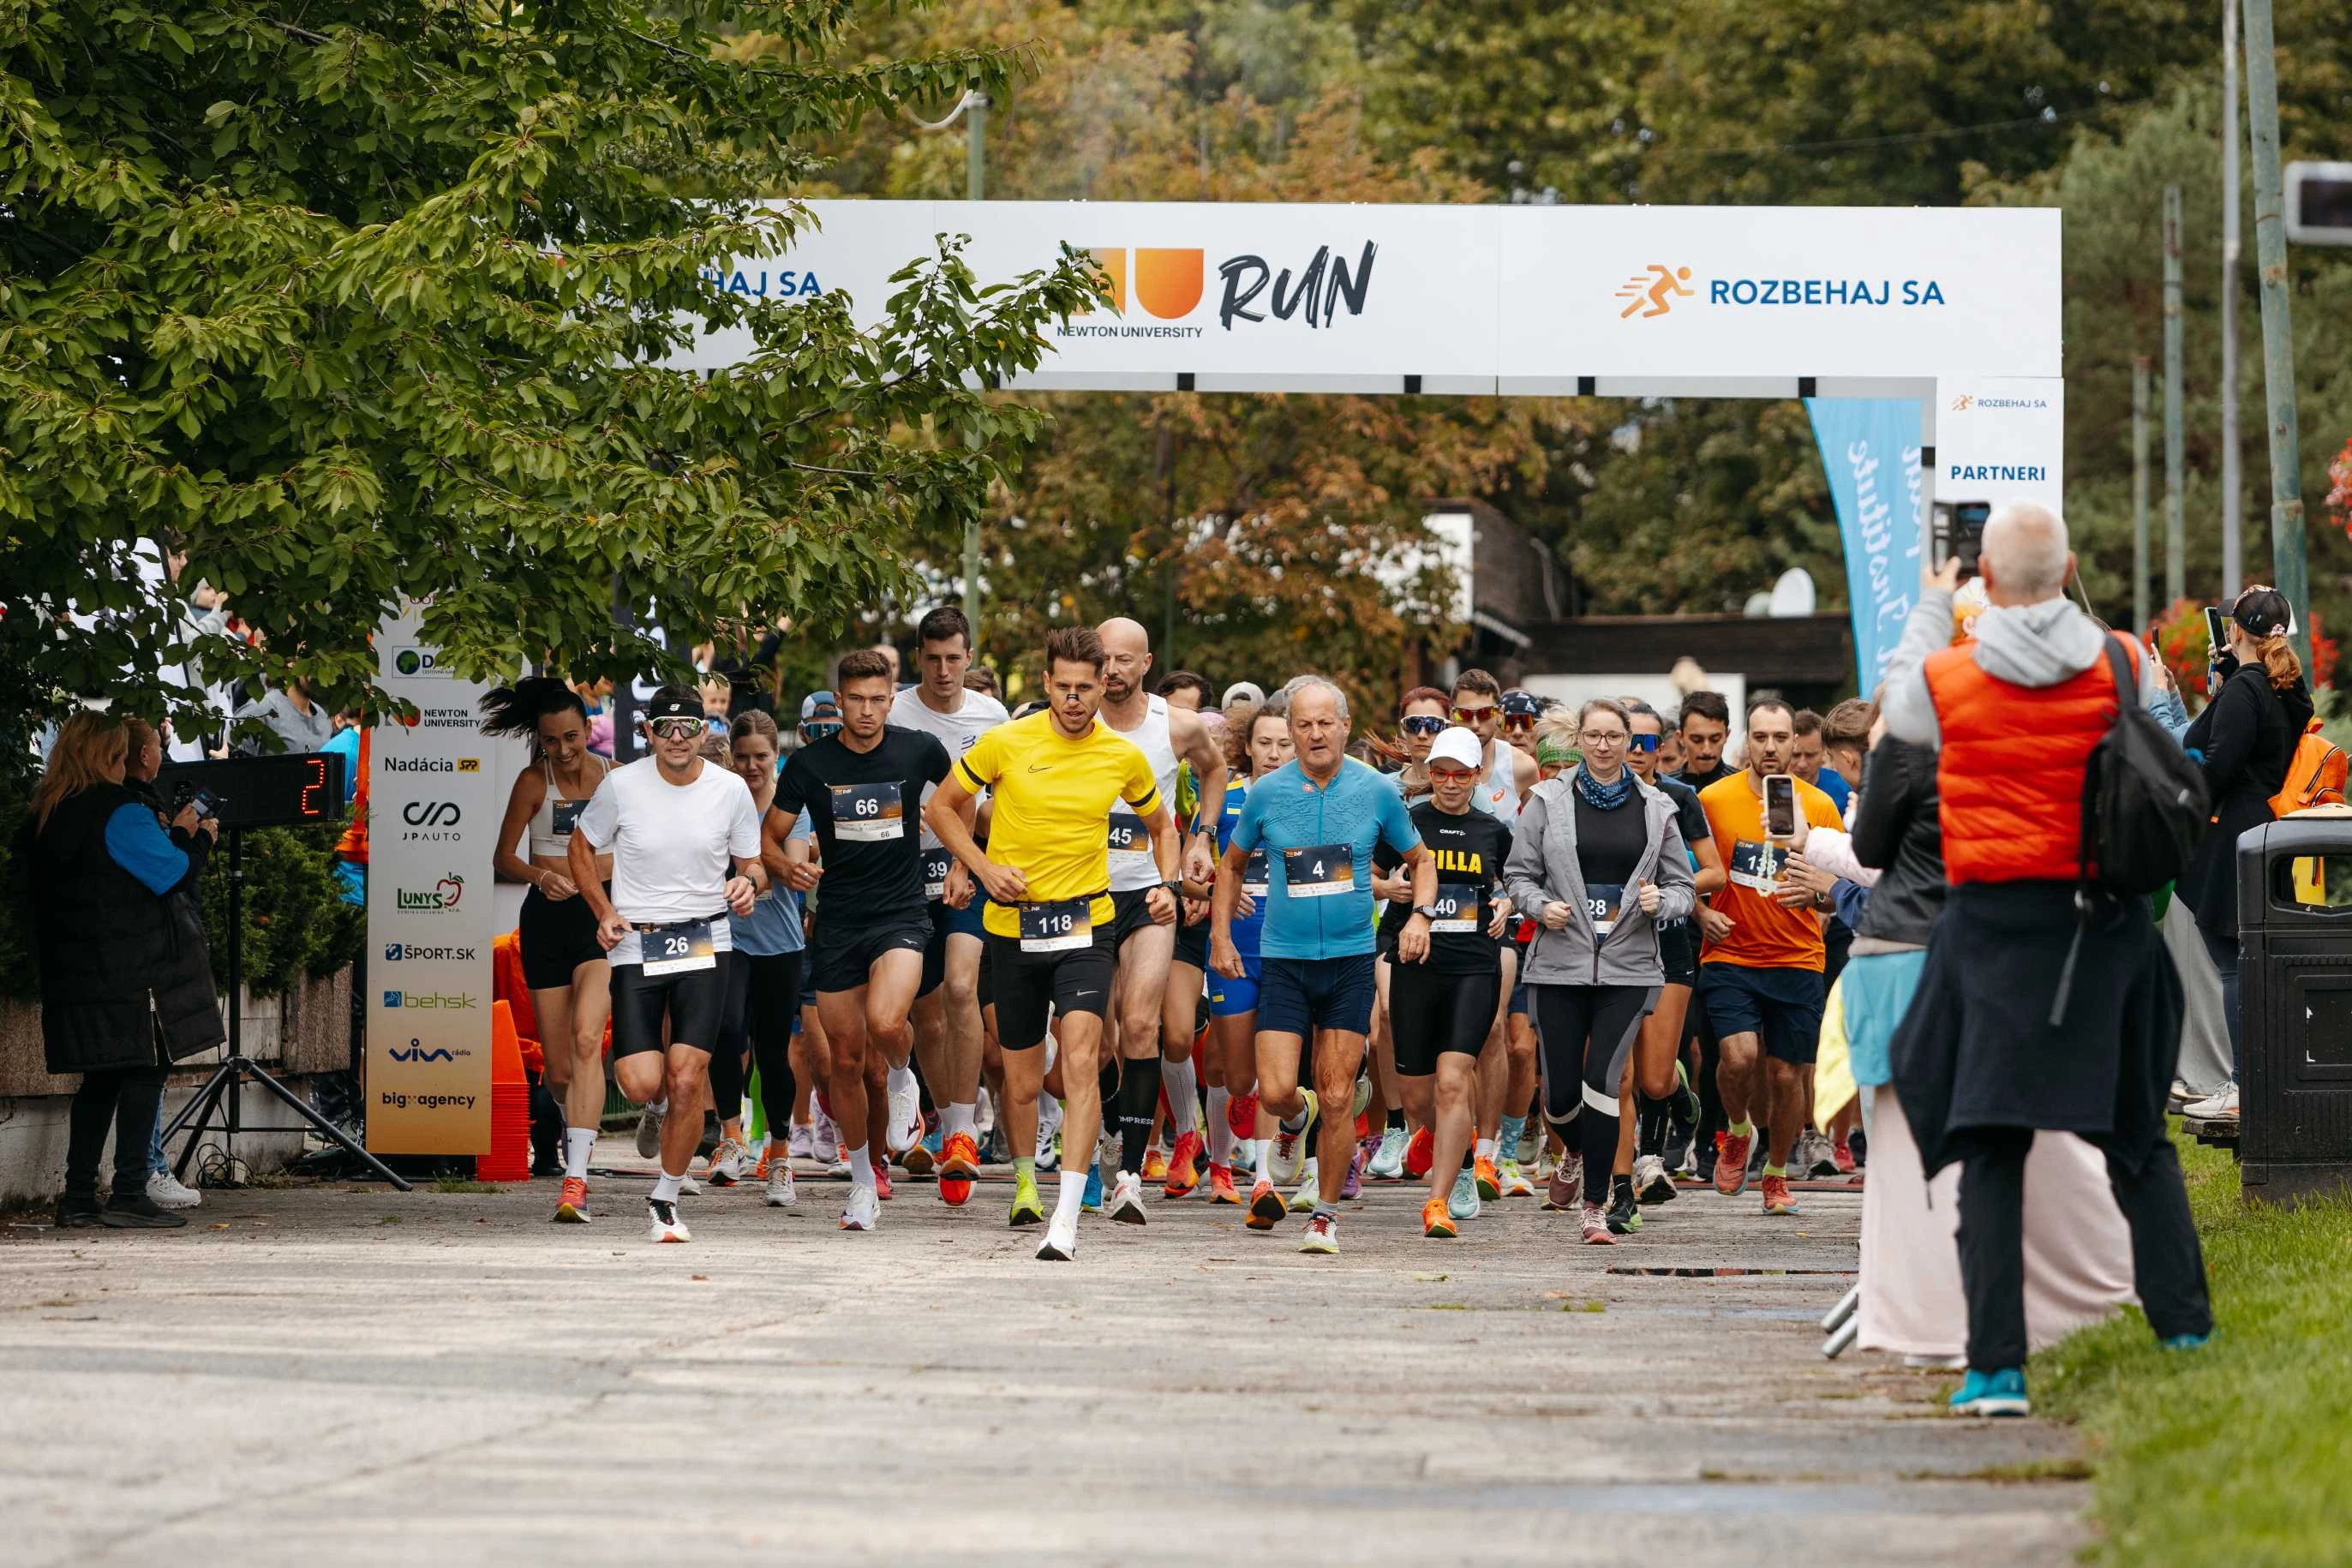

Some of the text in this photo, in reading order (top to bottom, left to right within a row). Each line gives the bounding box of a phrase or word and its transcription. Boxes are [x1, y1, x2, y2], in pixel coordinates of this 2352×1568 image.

[779, 271, 823, 296] SA
[1218, 239, 1378, 332] RUN
[1710, 279, 1946, 305] ROZBEHAJ SA
[1056, 326, 1203, 338] NEWTON UNIVERSITY
[1978, 398, 2047, 408] ROZBEHAJ SA
[1950, 465, 2046, 481] PARTNERI
[424, 709, 468, 717] NEWTON
[424, 719, 481, 727] UNIVERSITY
[385, 757, 453, 772] Nadácia
[302, 759, 325, 816] 2
[855, 798, 878, 816] 66
[1109, 827, 1132, 845] 45
[927, 861, 948, 878] 39
[1312, 859, 1325, 877] 4
[1435, 898, 1457, 914] 40
[1038, 914, 1073, 934] 118
[404, 944, 476, 960] ŠPORT.SK
[665, 937, 689, 955] 26
[404, 991, 476, 1008] behsk
